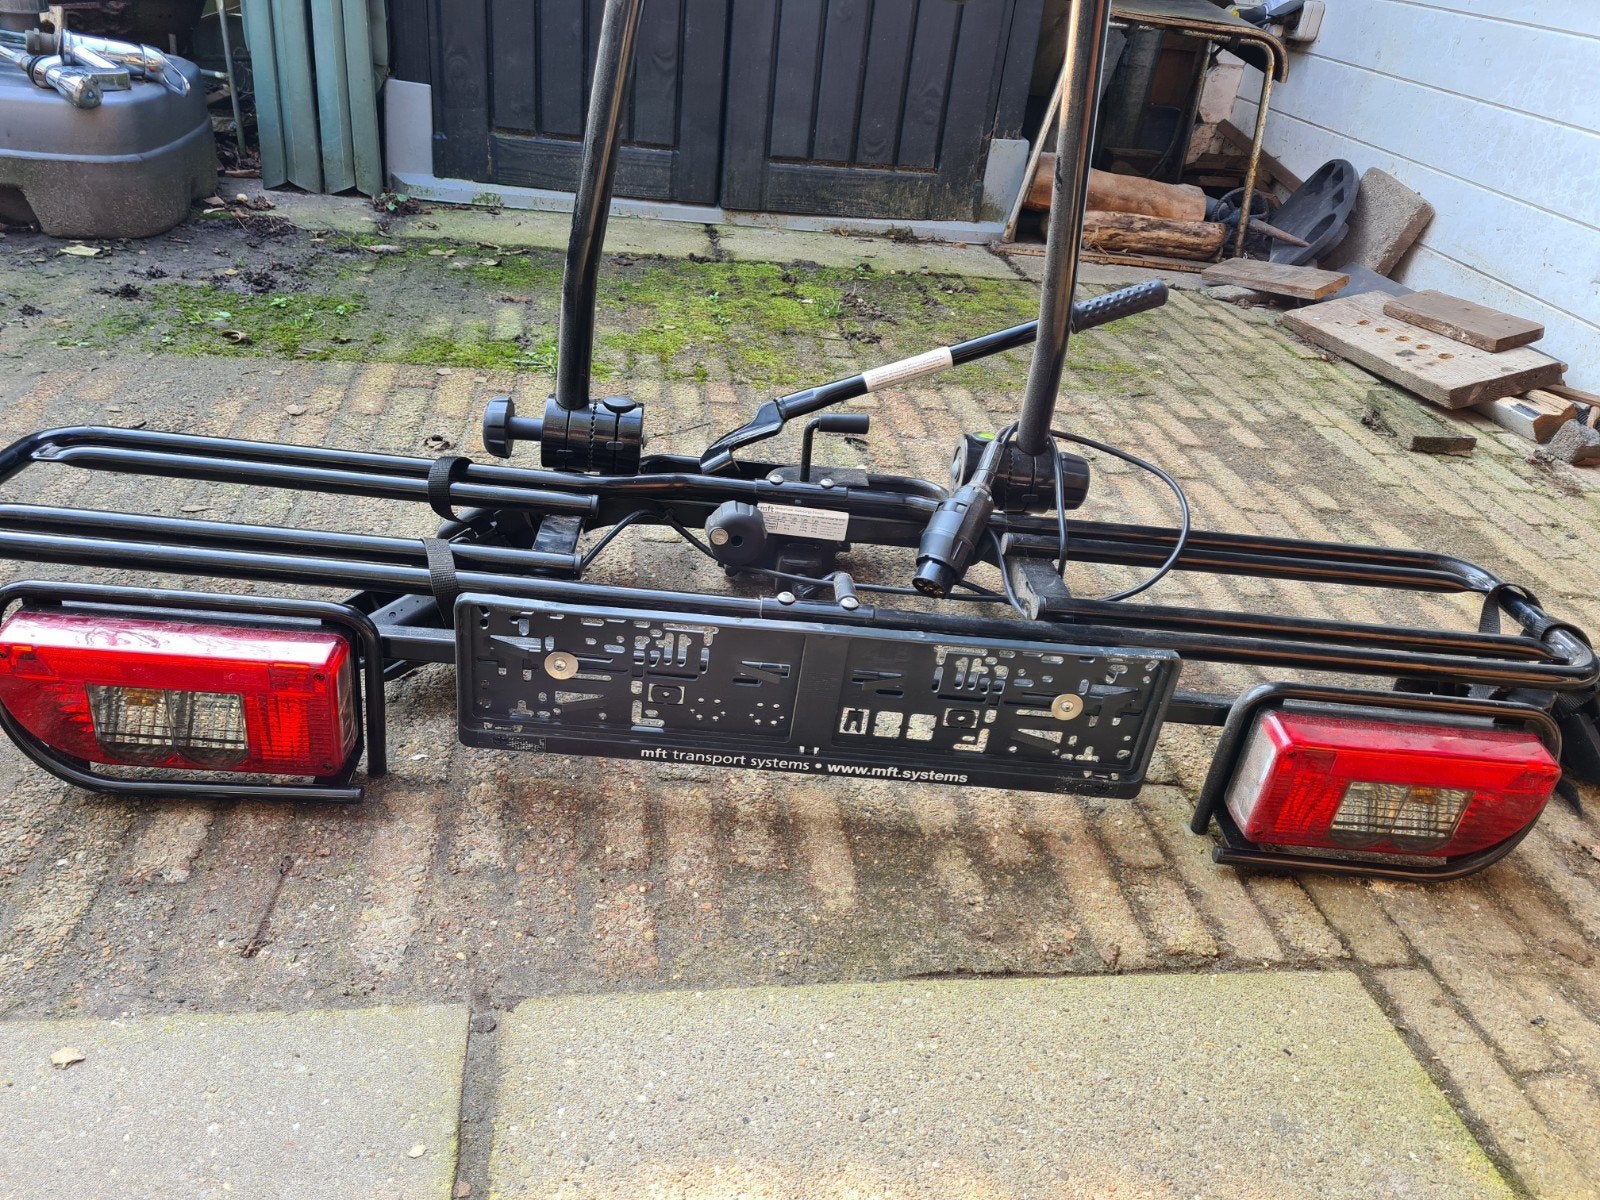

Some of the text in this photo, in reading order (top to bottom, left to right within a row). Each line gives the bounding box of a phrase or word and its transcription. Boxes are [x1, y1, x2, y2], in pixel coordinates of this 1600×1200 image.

[640, 748, 968, 783] mft transport systems www.mft.systems
